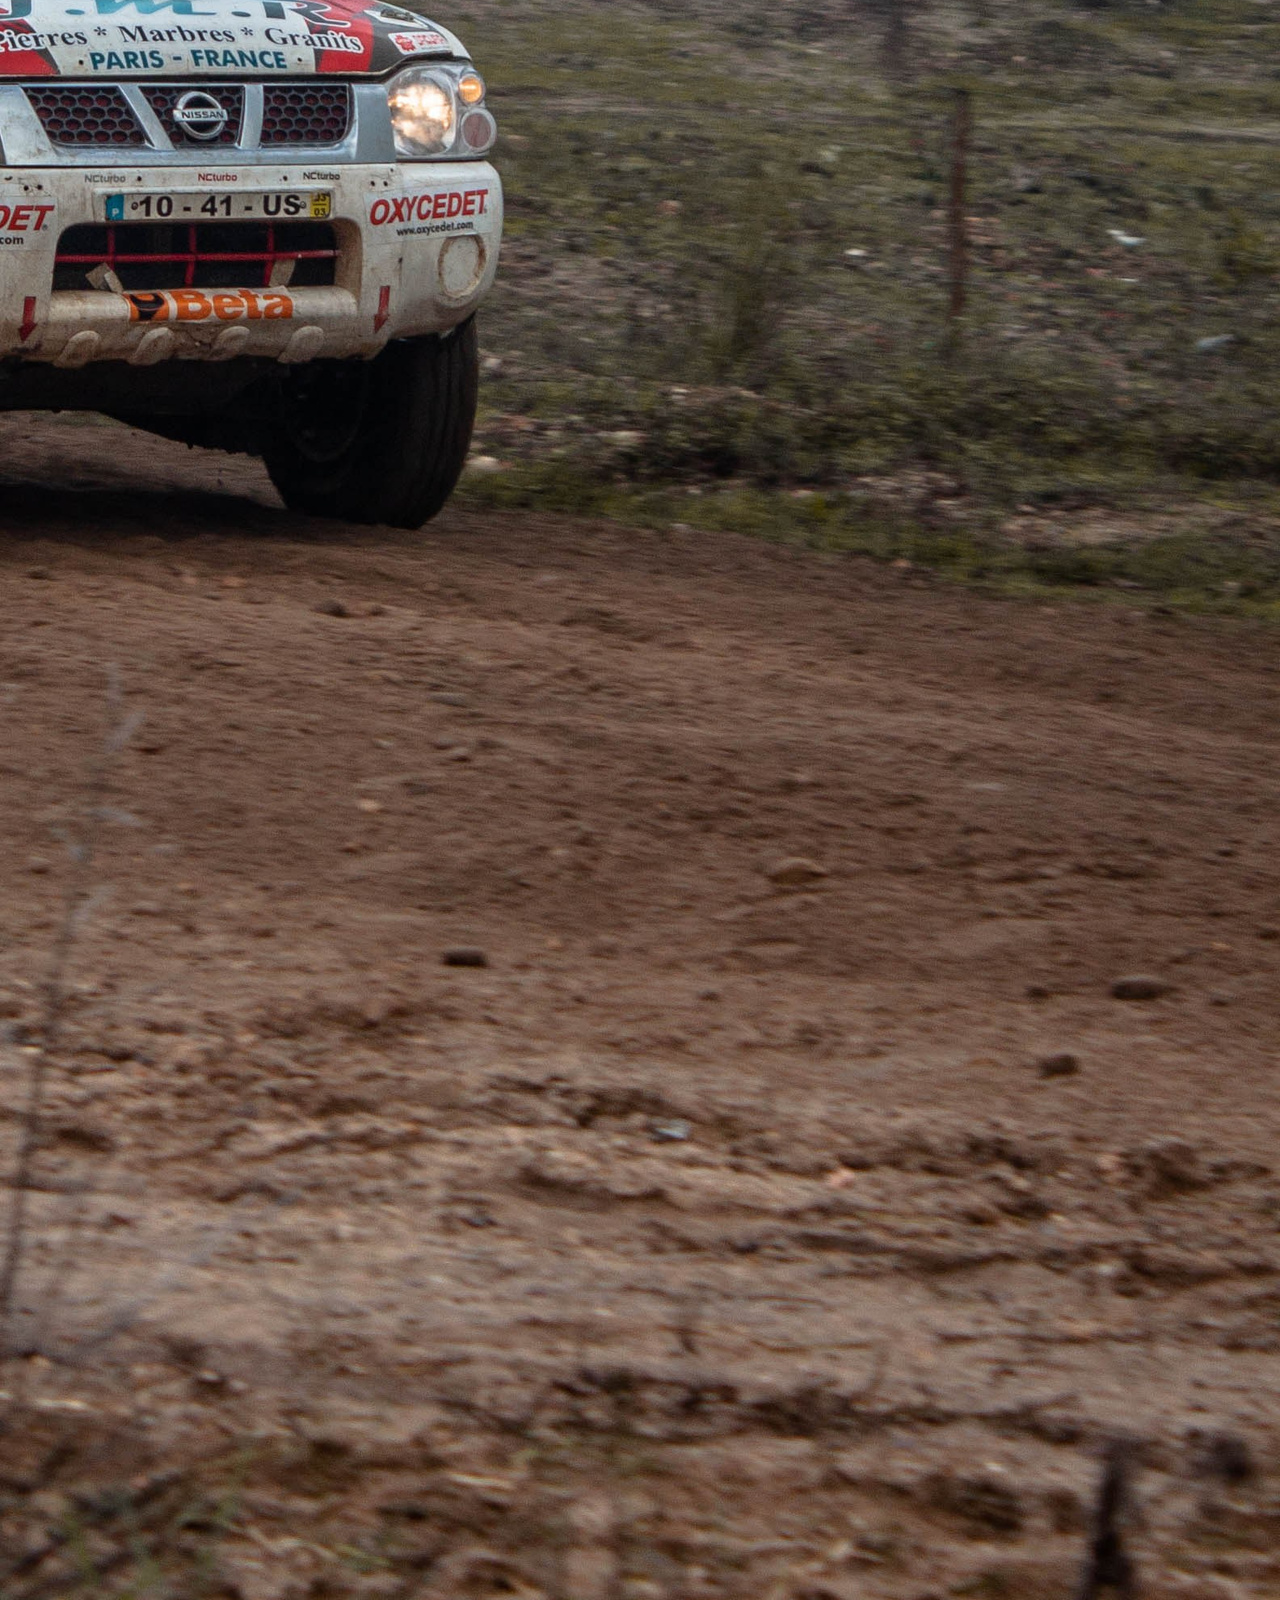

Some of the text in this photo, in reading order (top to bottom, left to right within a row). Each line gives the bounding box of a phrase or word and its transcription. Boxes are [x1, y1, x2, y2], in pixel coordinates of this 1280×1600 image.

[119, 24, 235, 43] Marbres
[265, 27, 363, 53] Granits
[90, 50, 165, 70] PARIS
[190, 49, 287, 69] FRANCE
[181, 110, 224, 119] NISSAN
[84, 174, 126, 183] NCturbo
[197, 173, 237, 182] NCturbo
[303, 172, 340, 180] NCturbo
[370, 189, 489, 226] OXYCEDET
[396, 221, 473, 237] www.oxycedet.com
[170, 289, 293, 320] Beta
